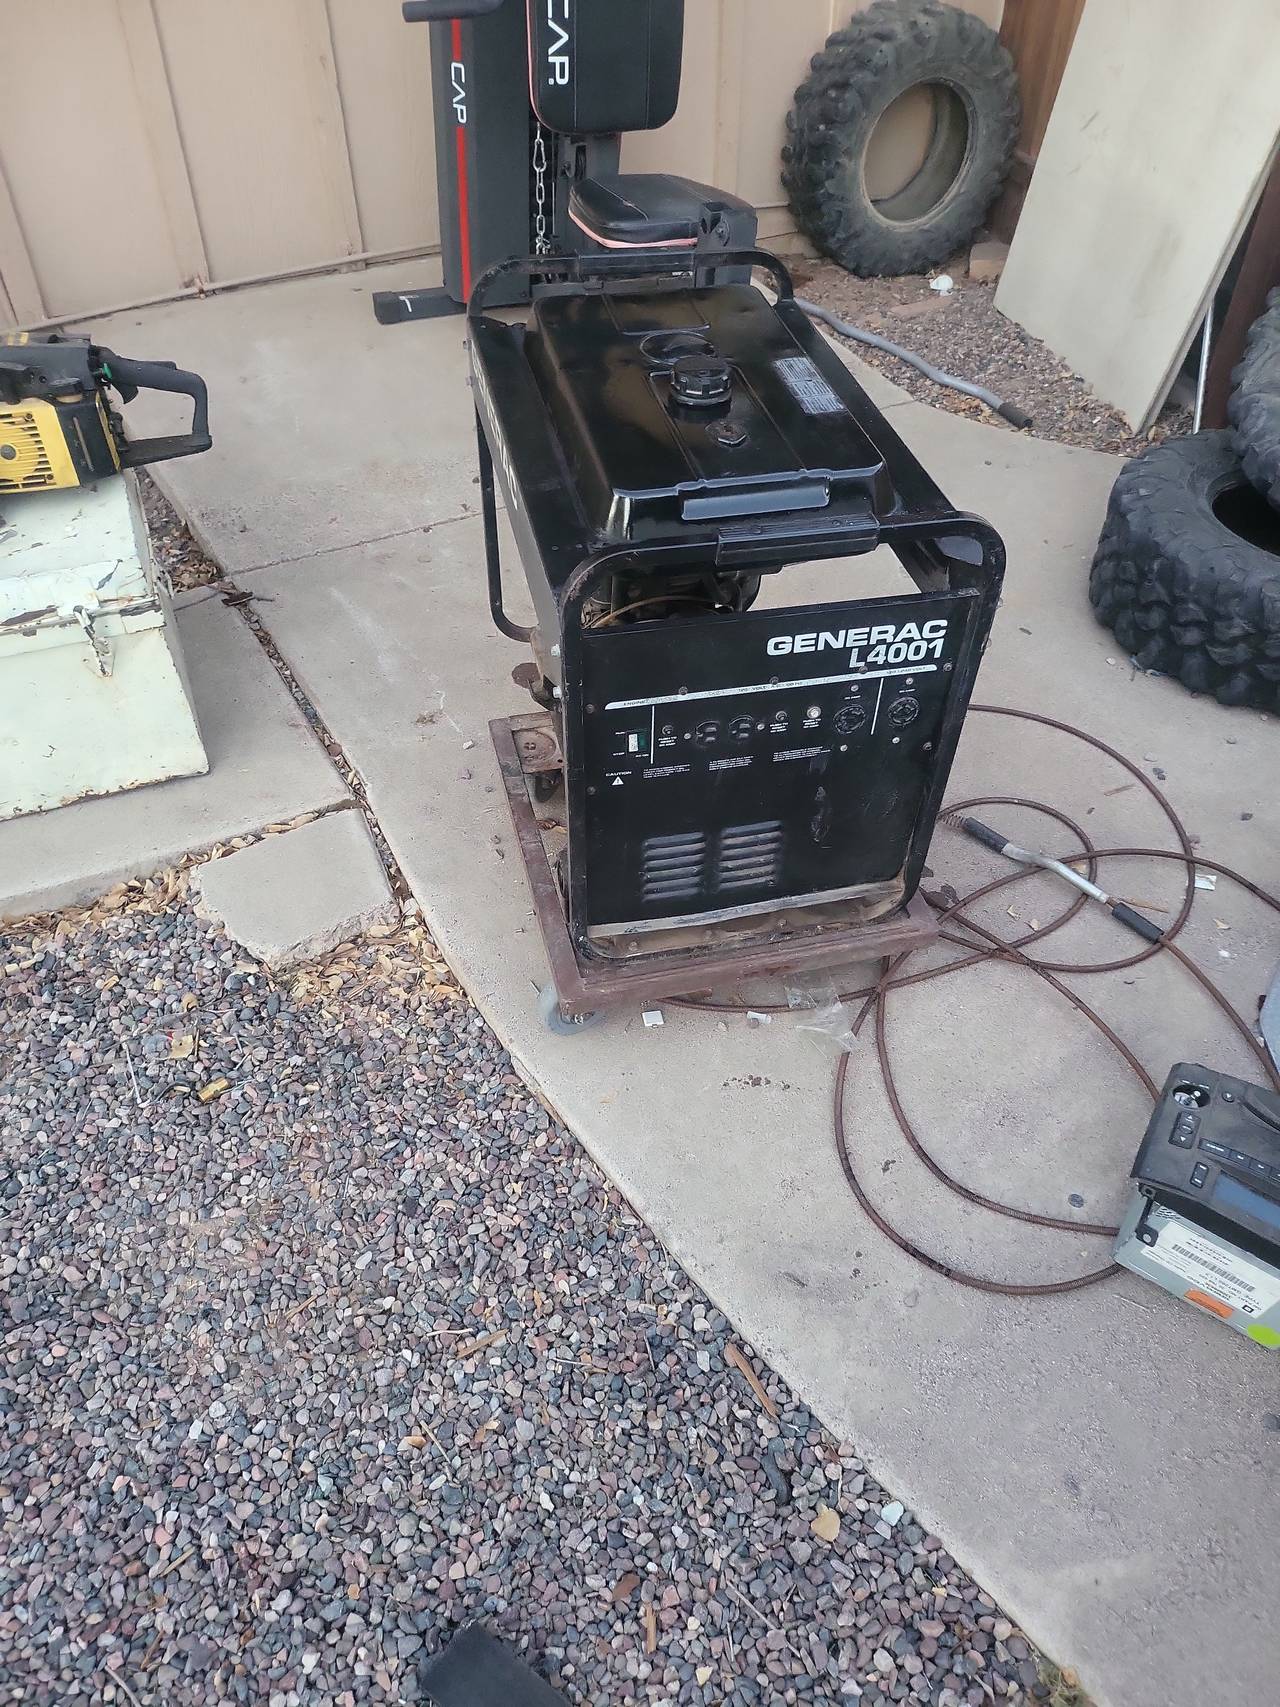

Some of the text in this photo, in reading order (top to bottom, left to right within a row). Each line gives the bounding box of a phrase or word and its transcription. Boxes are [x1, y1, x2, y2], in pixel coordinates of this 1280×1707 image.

[451, 62, 467, 124] CAP
[766, 619, 948, 656] GENERAC
[849, 638, 945, 668] L4001
